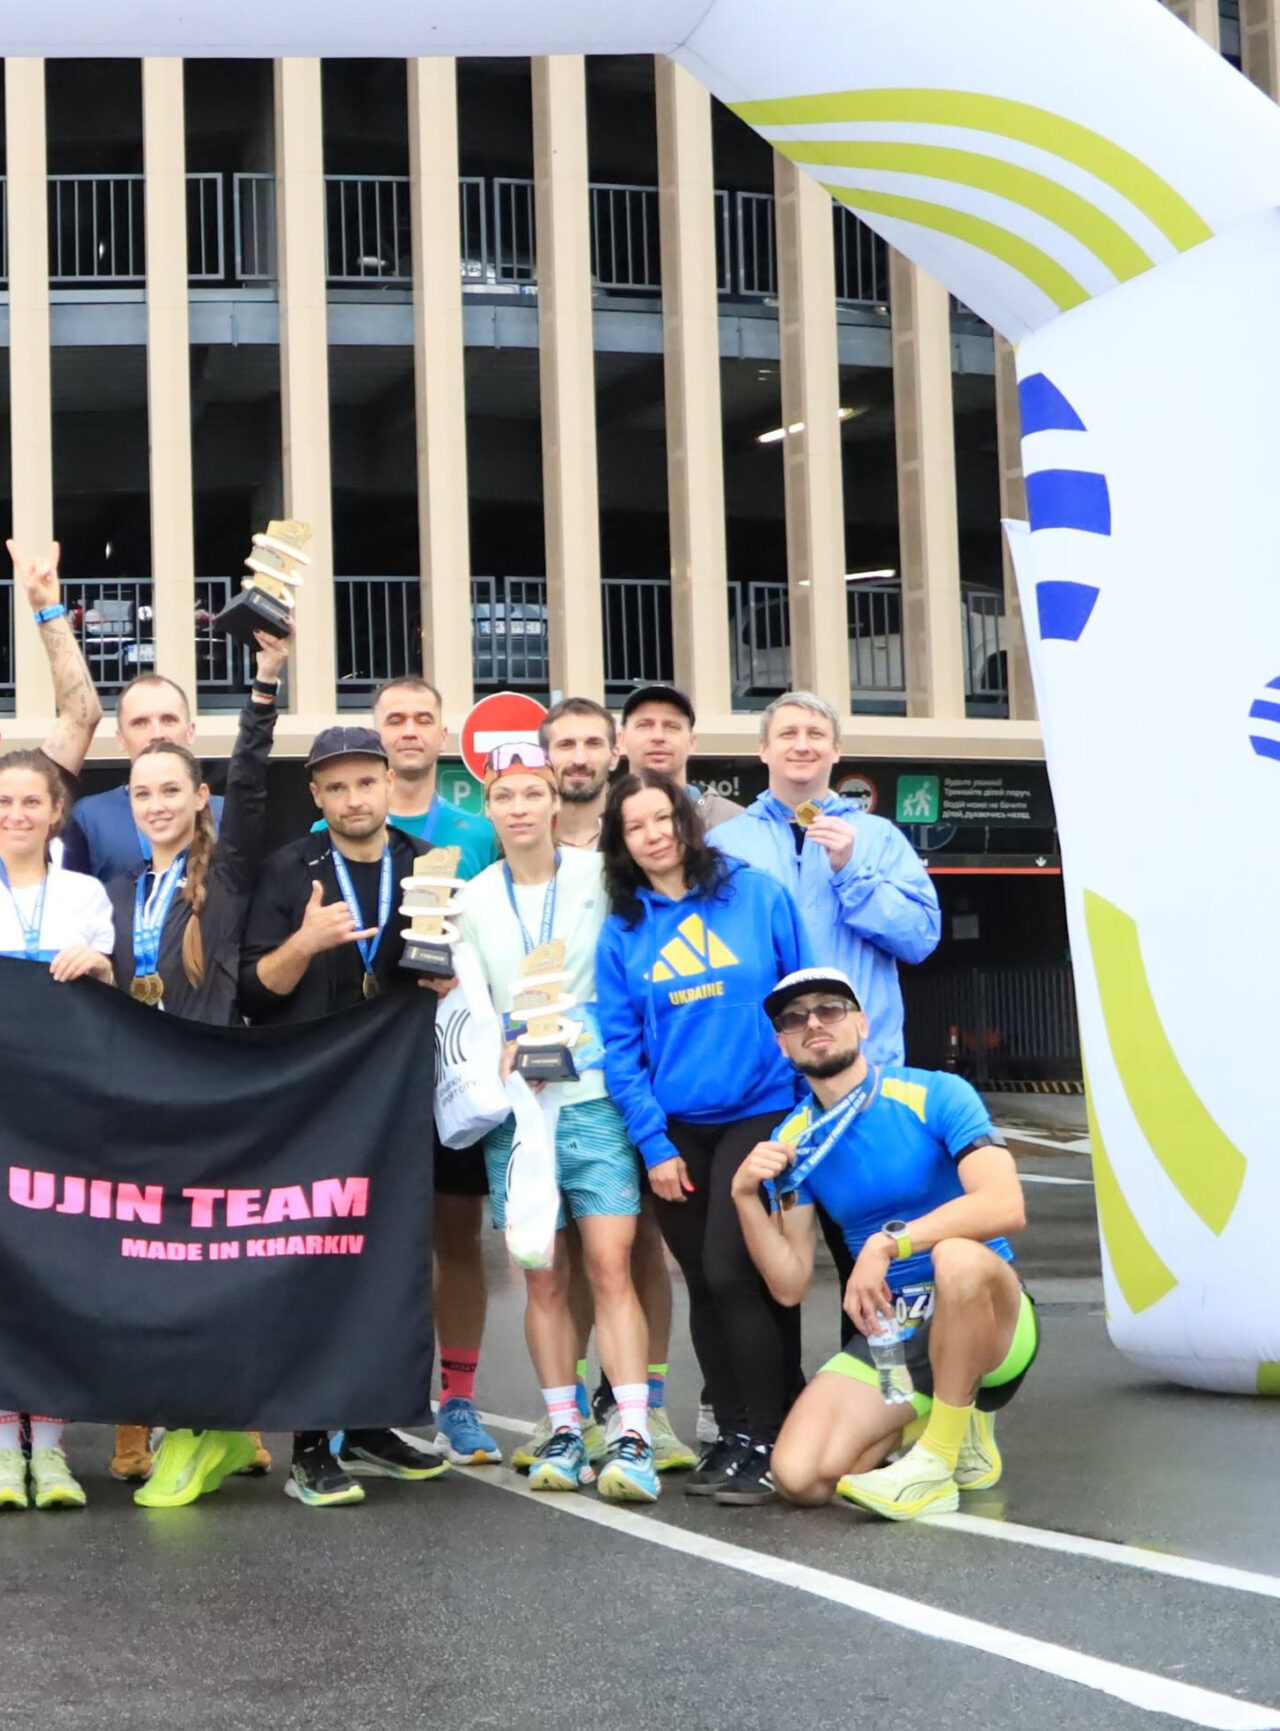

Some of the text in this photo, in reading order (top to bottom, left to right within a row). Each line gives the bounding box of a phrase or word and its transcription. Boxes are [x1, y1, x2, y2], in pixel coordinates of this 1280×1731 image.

[453, 781, 471, 806] P
[668, 981, 724, 1005] UKRAINE
[9, 1166, 369, 1227] UJIN TEAM
[121, 1234, 364, 1261] MADE IN KHARKIV
